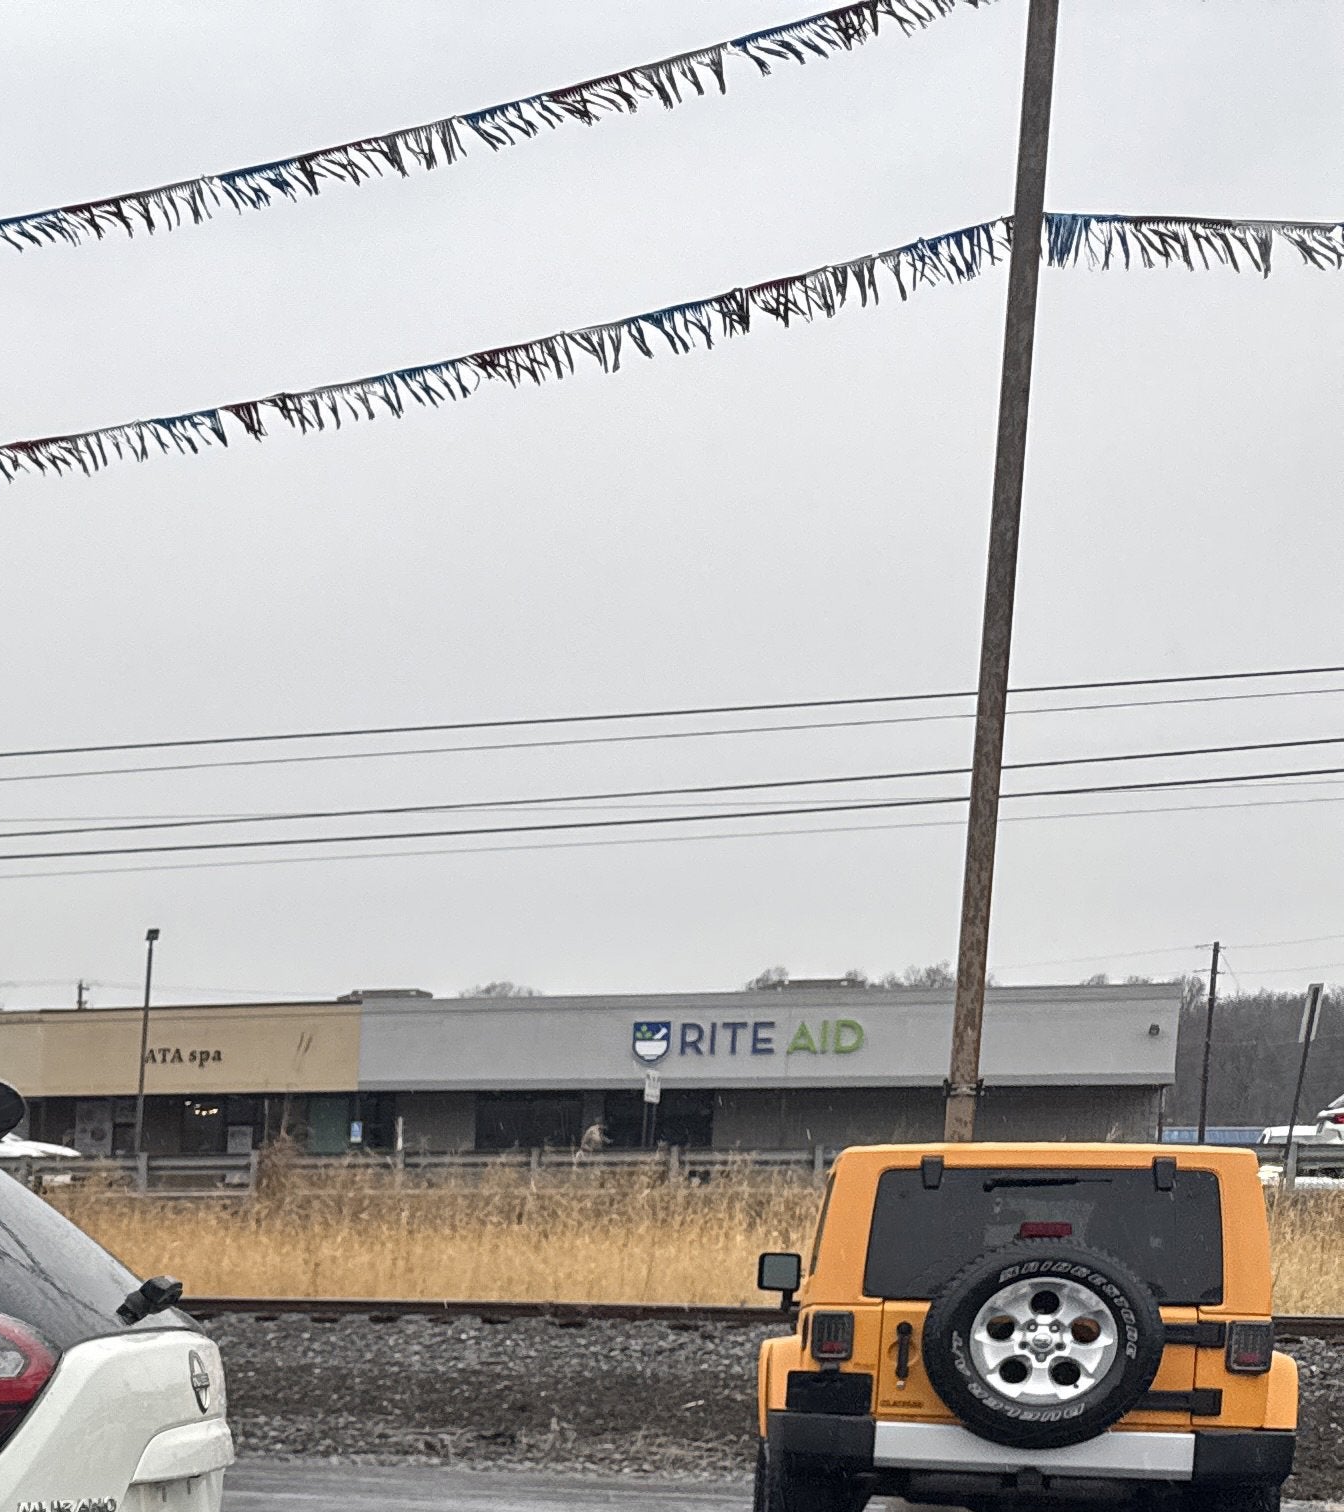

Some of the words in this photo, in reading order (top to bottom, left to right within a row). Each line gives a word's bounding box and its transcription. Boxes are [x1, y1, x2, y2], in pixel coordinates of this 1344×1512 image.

[679, 1020, 776, 1056] RITE
[786, 1019, 865, 1055] AID
[188, 1049, 223, 1069] spa
